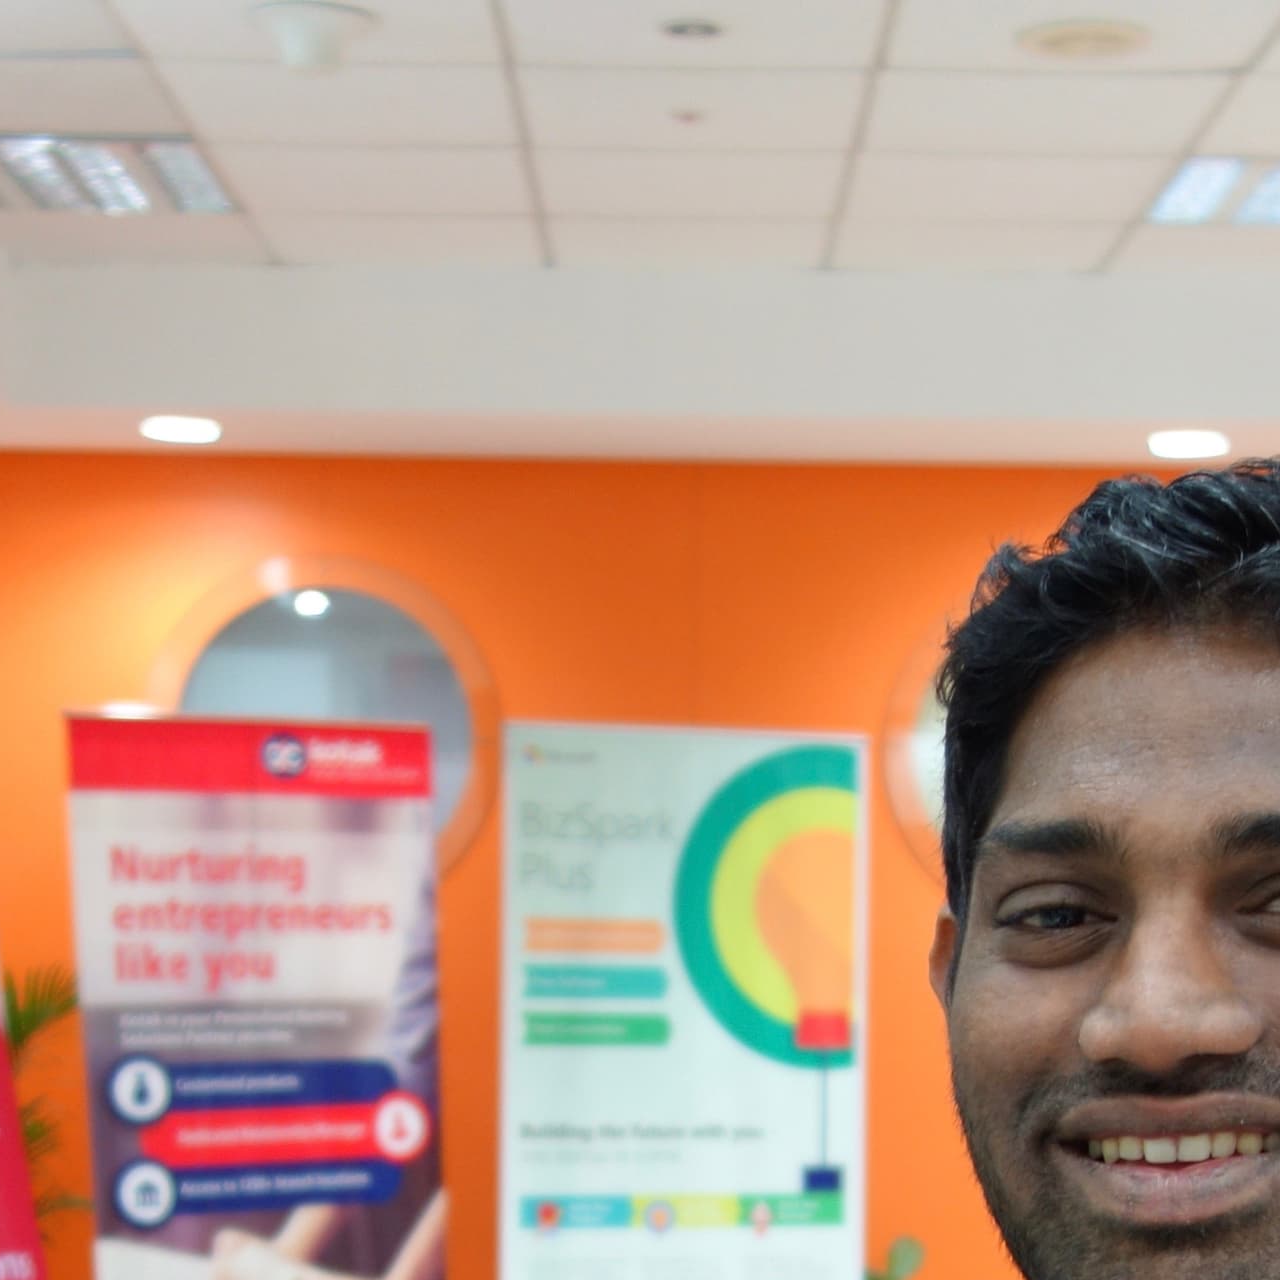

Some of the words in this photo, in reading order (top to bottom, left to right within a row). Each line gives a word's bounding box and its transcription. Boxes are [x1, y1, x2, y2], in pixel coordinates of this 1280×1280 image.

[521, 803, 673, 846] BizSpark
[109, 846, 306, 891] Nurturing
[521, 852, 593, 889] Plus
[113, 896, 391, 940] entrepreneurs
[114, 945, 190, 983] like
[202, 951, 277, 992] you
